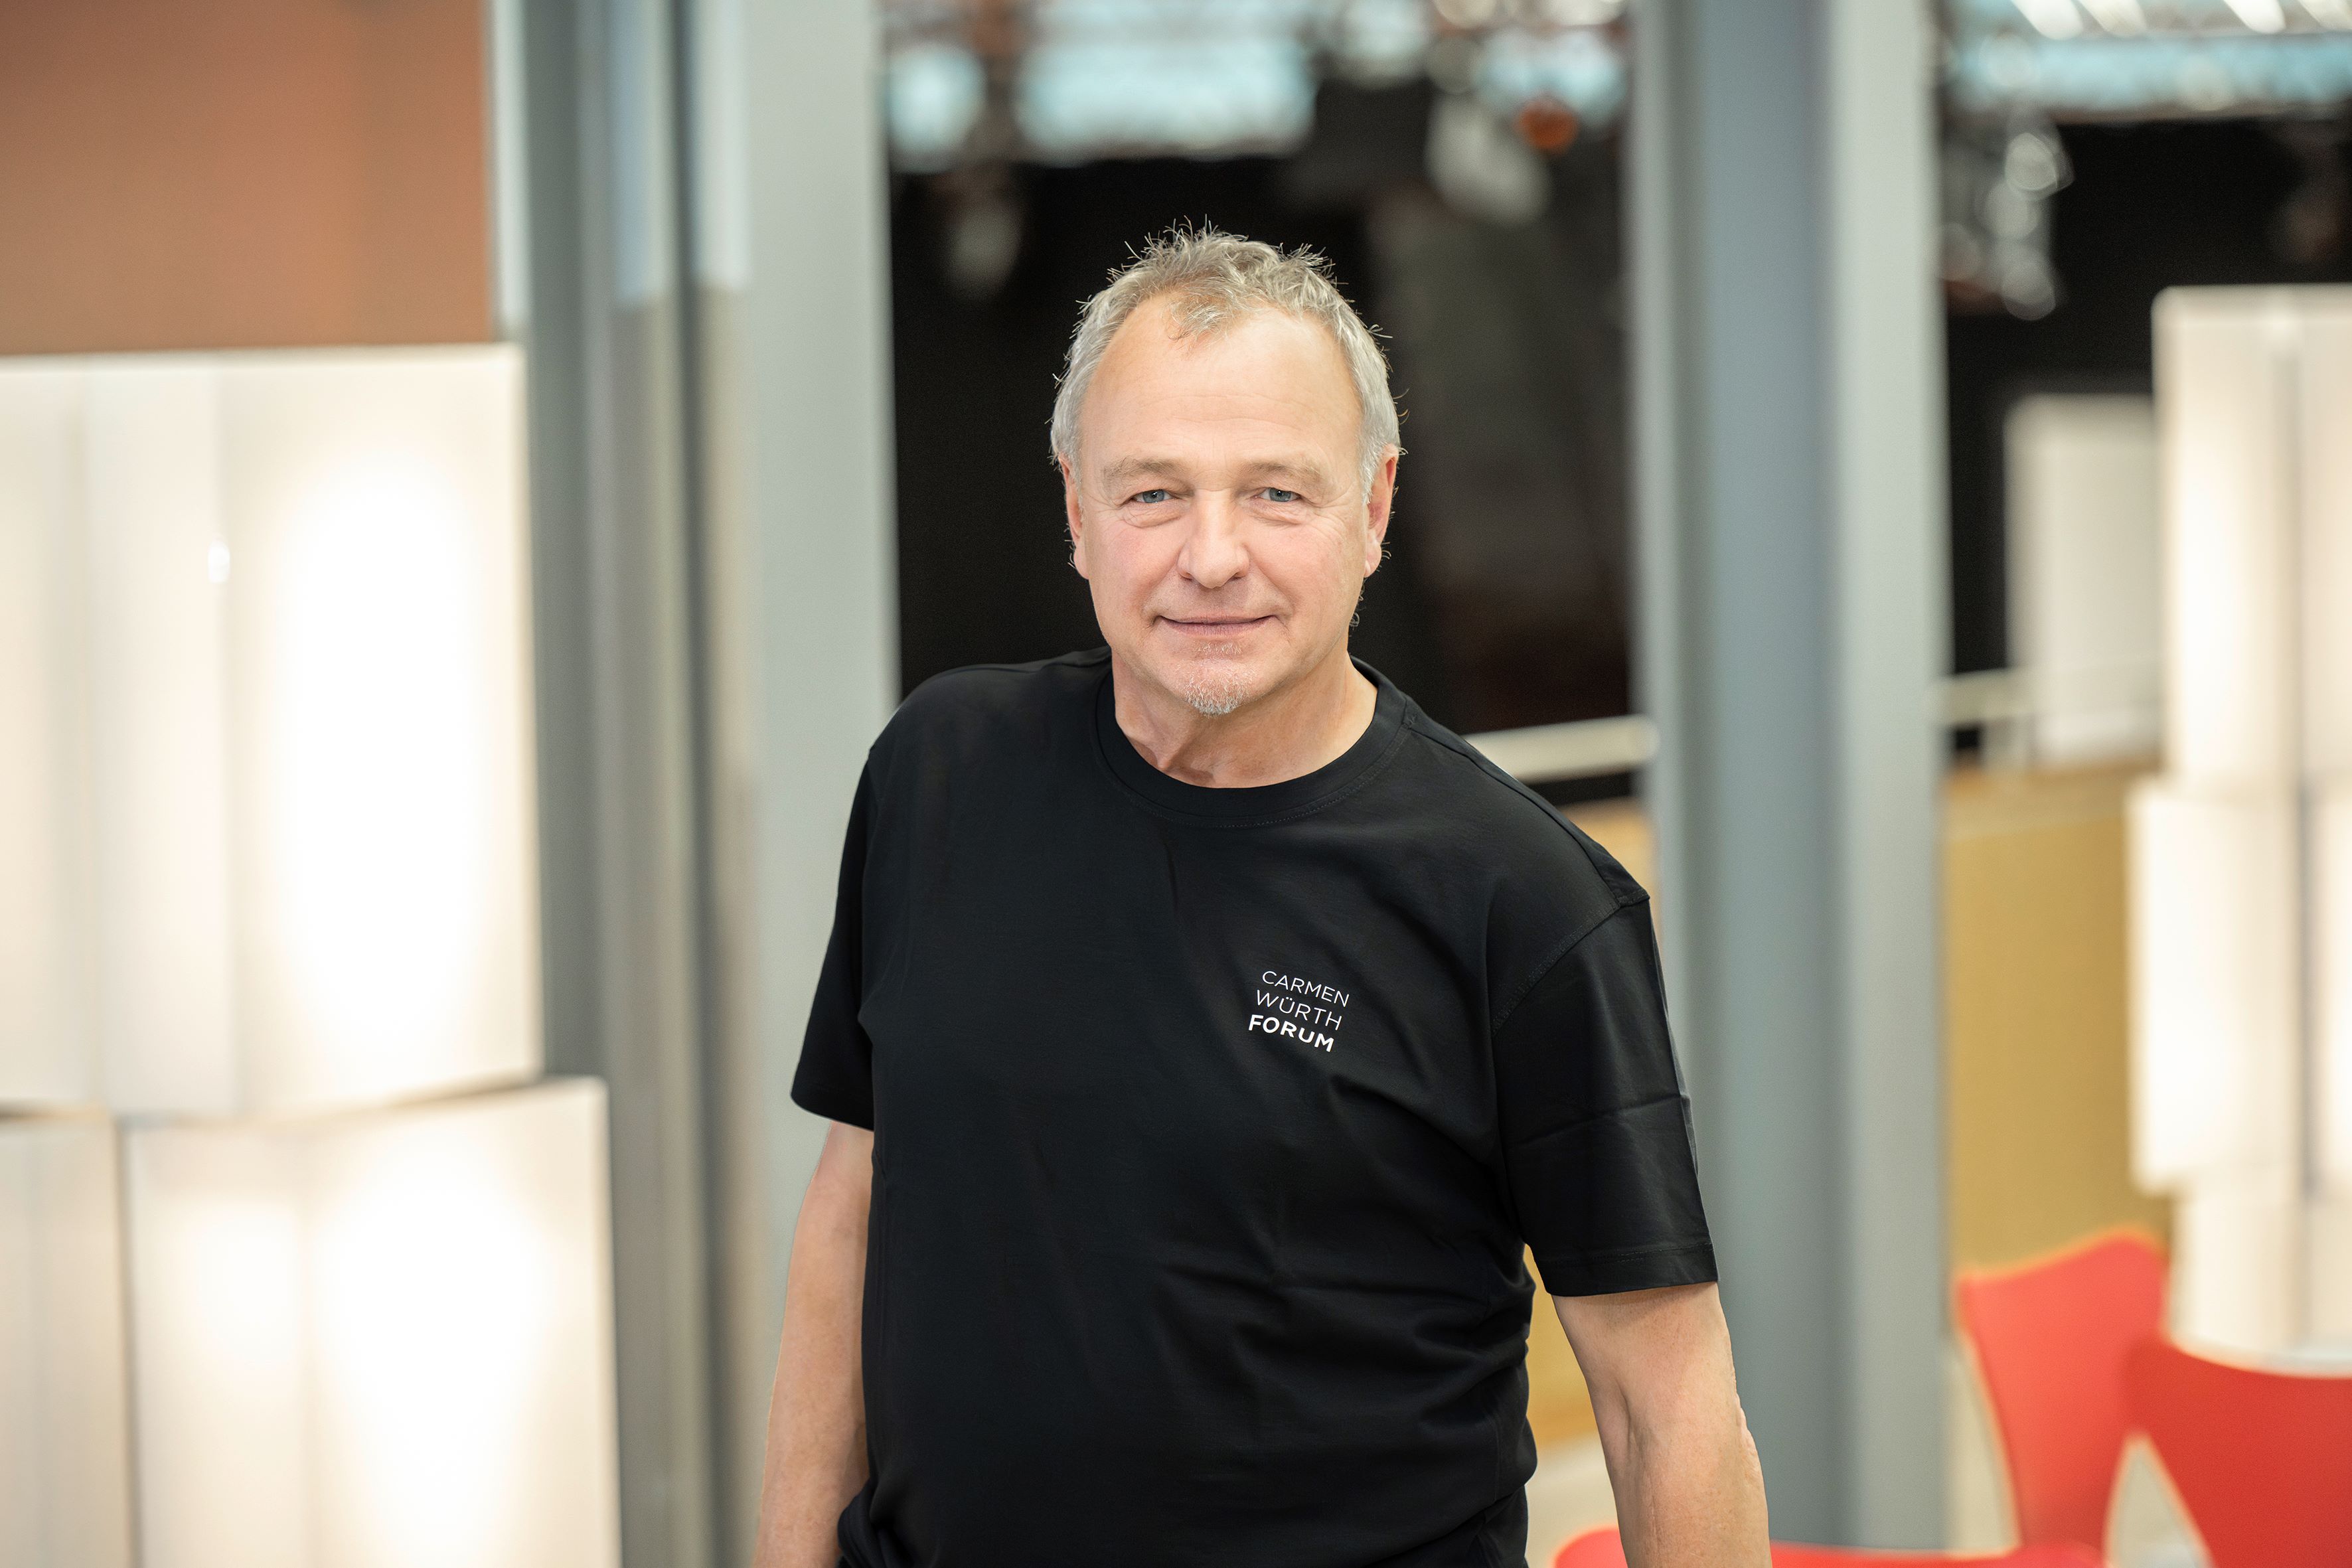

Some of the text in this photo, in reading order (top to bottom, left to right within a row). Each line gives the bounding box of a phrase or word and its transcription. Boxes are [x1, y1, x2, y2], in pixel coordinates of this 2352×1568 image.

[1262, 971, 1350, 1008] CARMEN
[1257, 989, 1342, 1031] WÜRTH
[1248, 1014, 1334, 1053] FORUM
